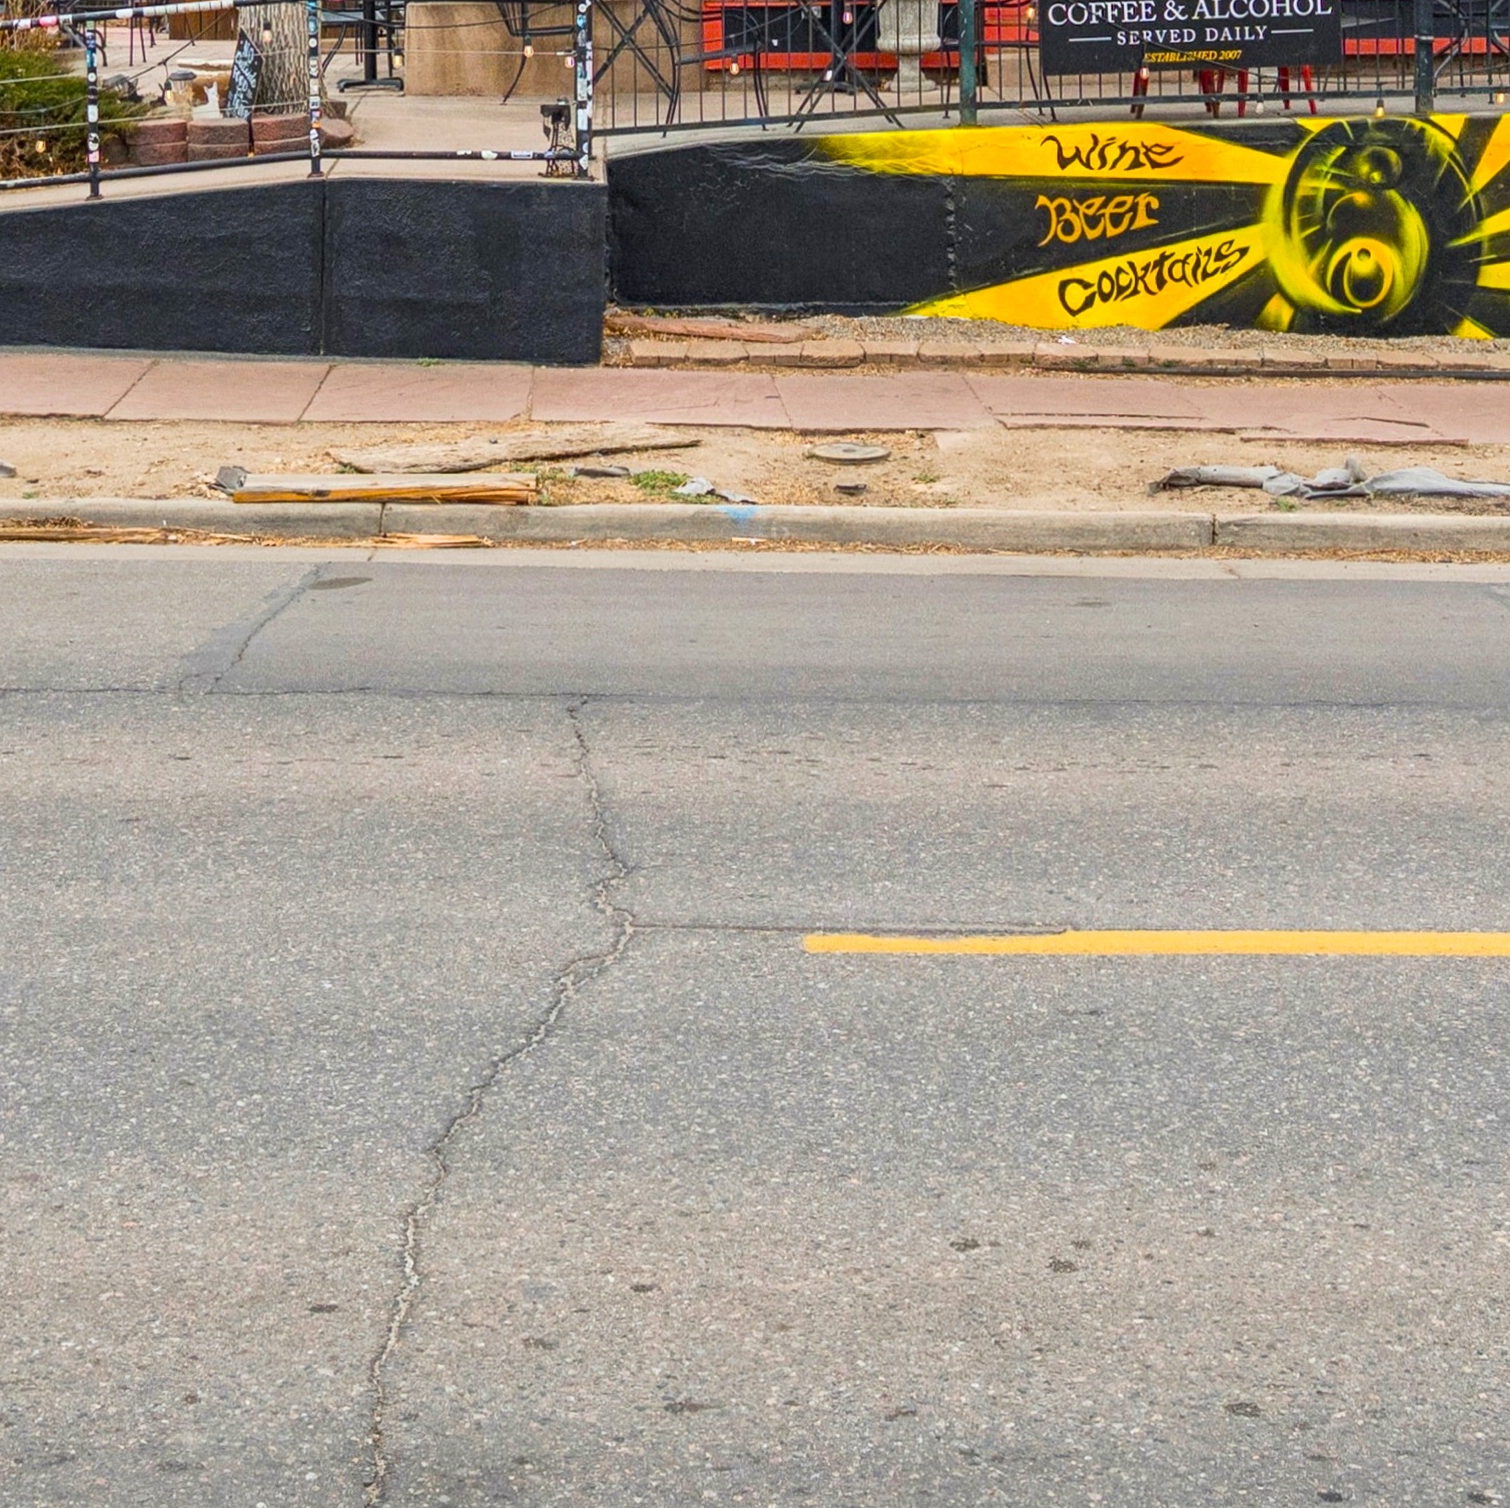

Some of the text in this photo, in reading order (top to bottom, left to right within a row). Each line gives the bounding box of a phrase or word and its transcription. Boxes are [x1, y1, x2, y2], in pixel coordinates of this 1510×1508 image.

[1048, 0, 1157, 26] COFFEE
[1163, 0, 1189, 21] &
[1117, 25, 1268, 45] SERVED DAILY
[1144, 49, 1242, 63] ESTABLISHED 2007
[1040, 133, 1184, 171] Wine
[1034, 192, 1160, 247] Beer
[1057, 239, 1251, 318] Cocktails
